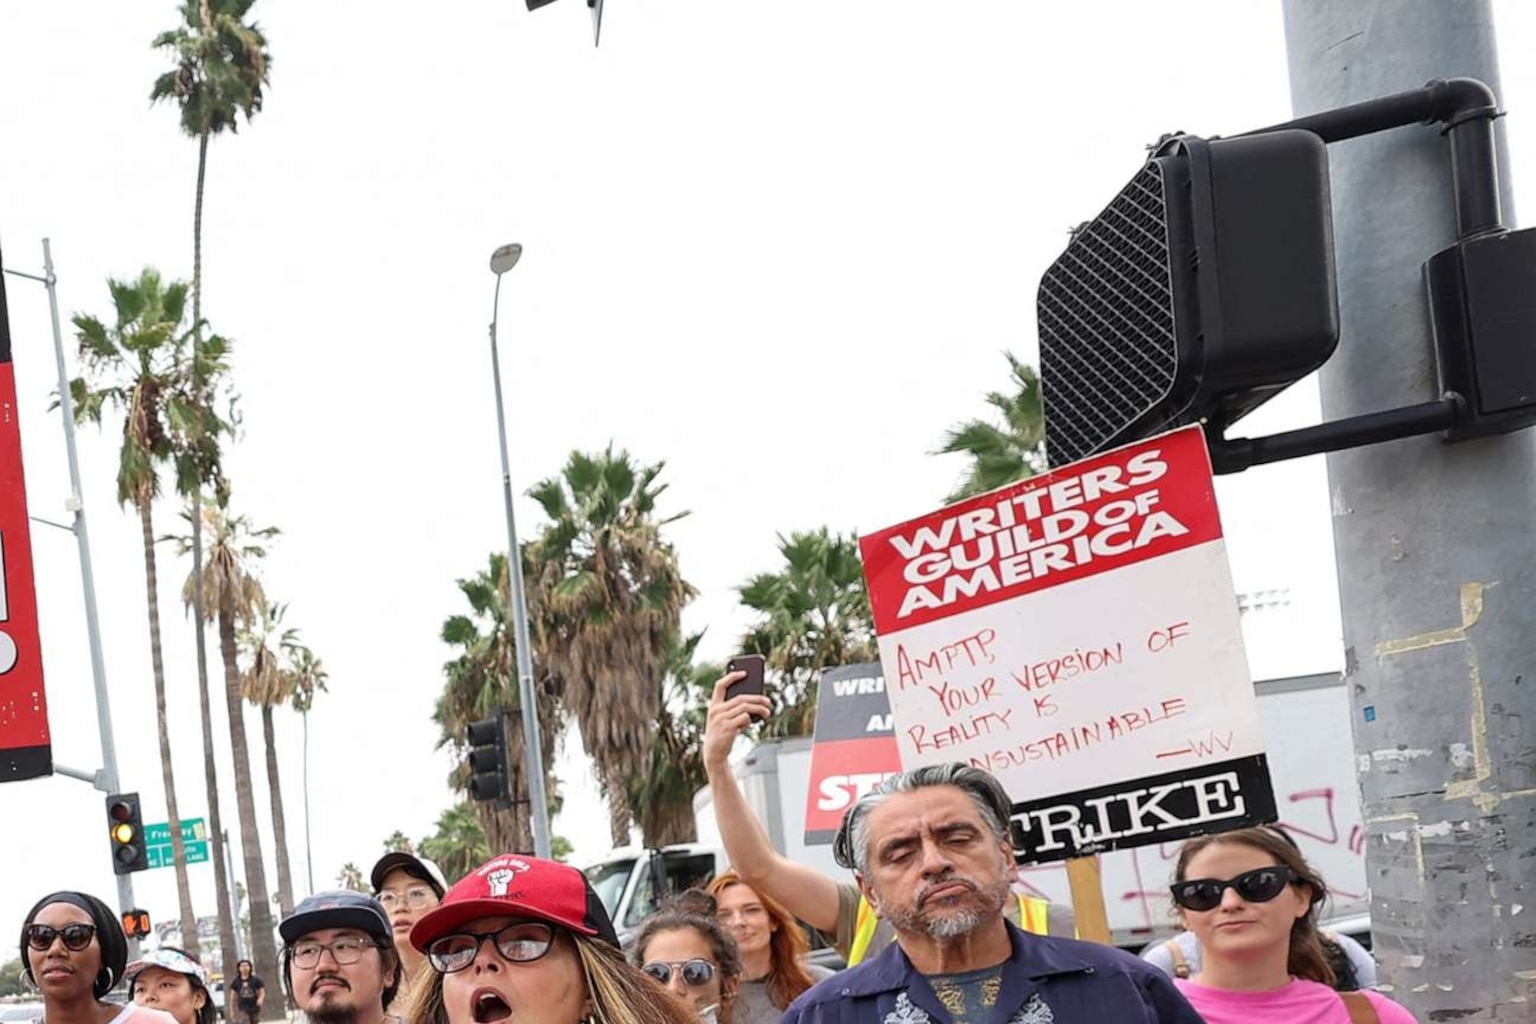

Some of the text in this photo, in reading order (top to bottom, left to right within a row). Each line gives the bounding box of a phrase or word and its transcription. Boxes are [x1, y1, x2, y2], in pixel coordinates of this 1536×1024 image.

[889, 449, 1167, 560] WRITERS
[903, 489, 1159, 586] GUILD OF
[896, 511, 1190, 619] AMERICA
[929, 676, 1004, 717] YOUR
[1012, 642, 1124, 691] VERSION
[1148, 622, 1189, 652] OF
[908, 708, 1013, 755] REALITY
[1034, 694, 1059, 717] IS
[964, 698, 1186, 772] NSUSTAINABLE
[1010, 771, 1246, 857] RIKE
